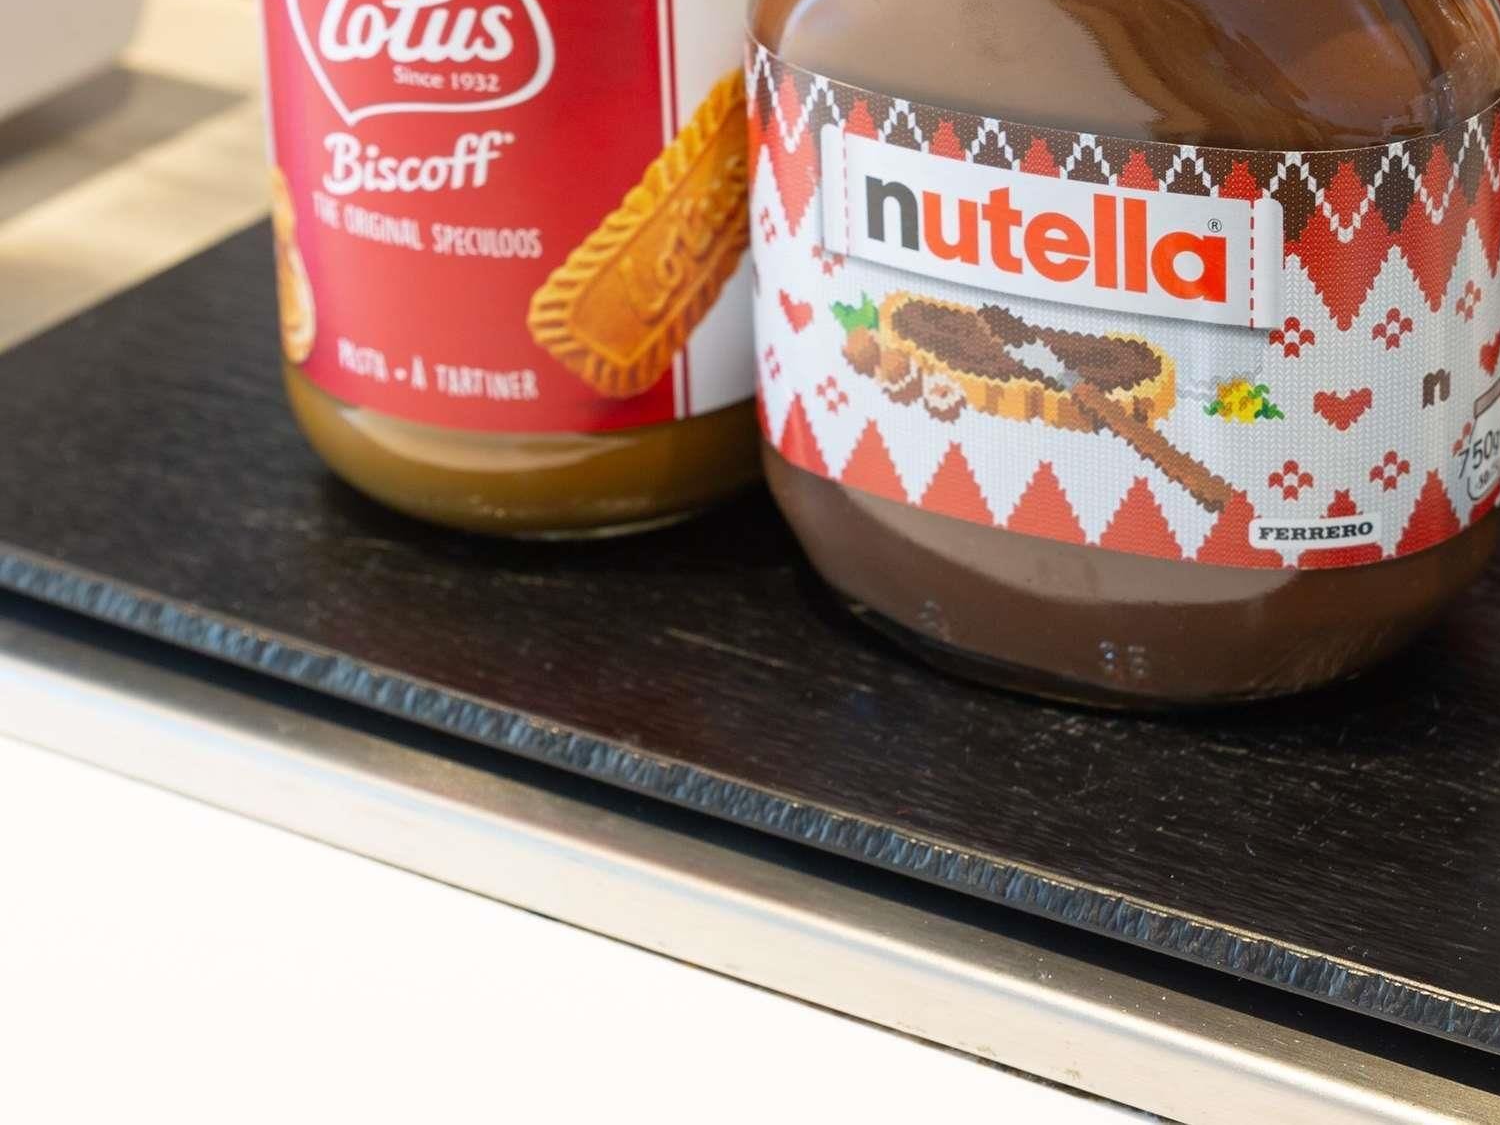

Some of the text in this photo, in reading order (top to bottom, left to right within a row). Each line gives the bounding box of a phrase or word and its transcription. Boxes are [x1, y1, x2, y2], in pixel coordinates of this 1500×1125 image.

[392, 65, 501, 94] Since 1932
[322, 130, 504, 196] Biscoff
[343, 203, 425, 252] ORIGINAL
[431, 223, 544, 260] SPECULOOS
[865, 175, 1227, 304] nutella
[1258, 521, 1374, 541] FERRERO
